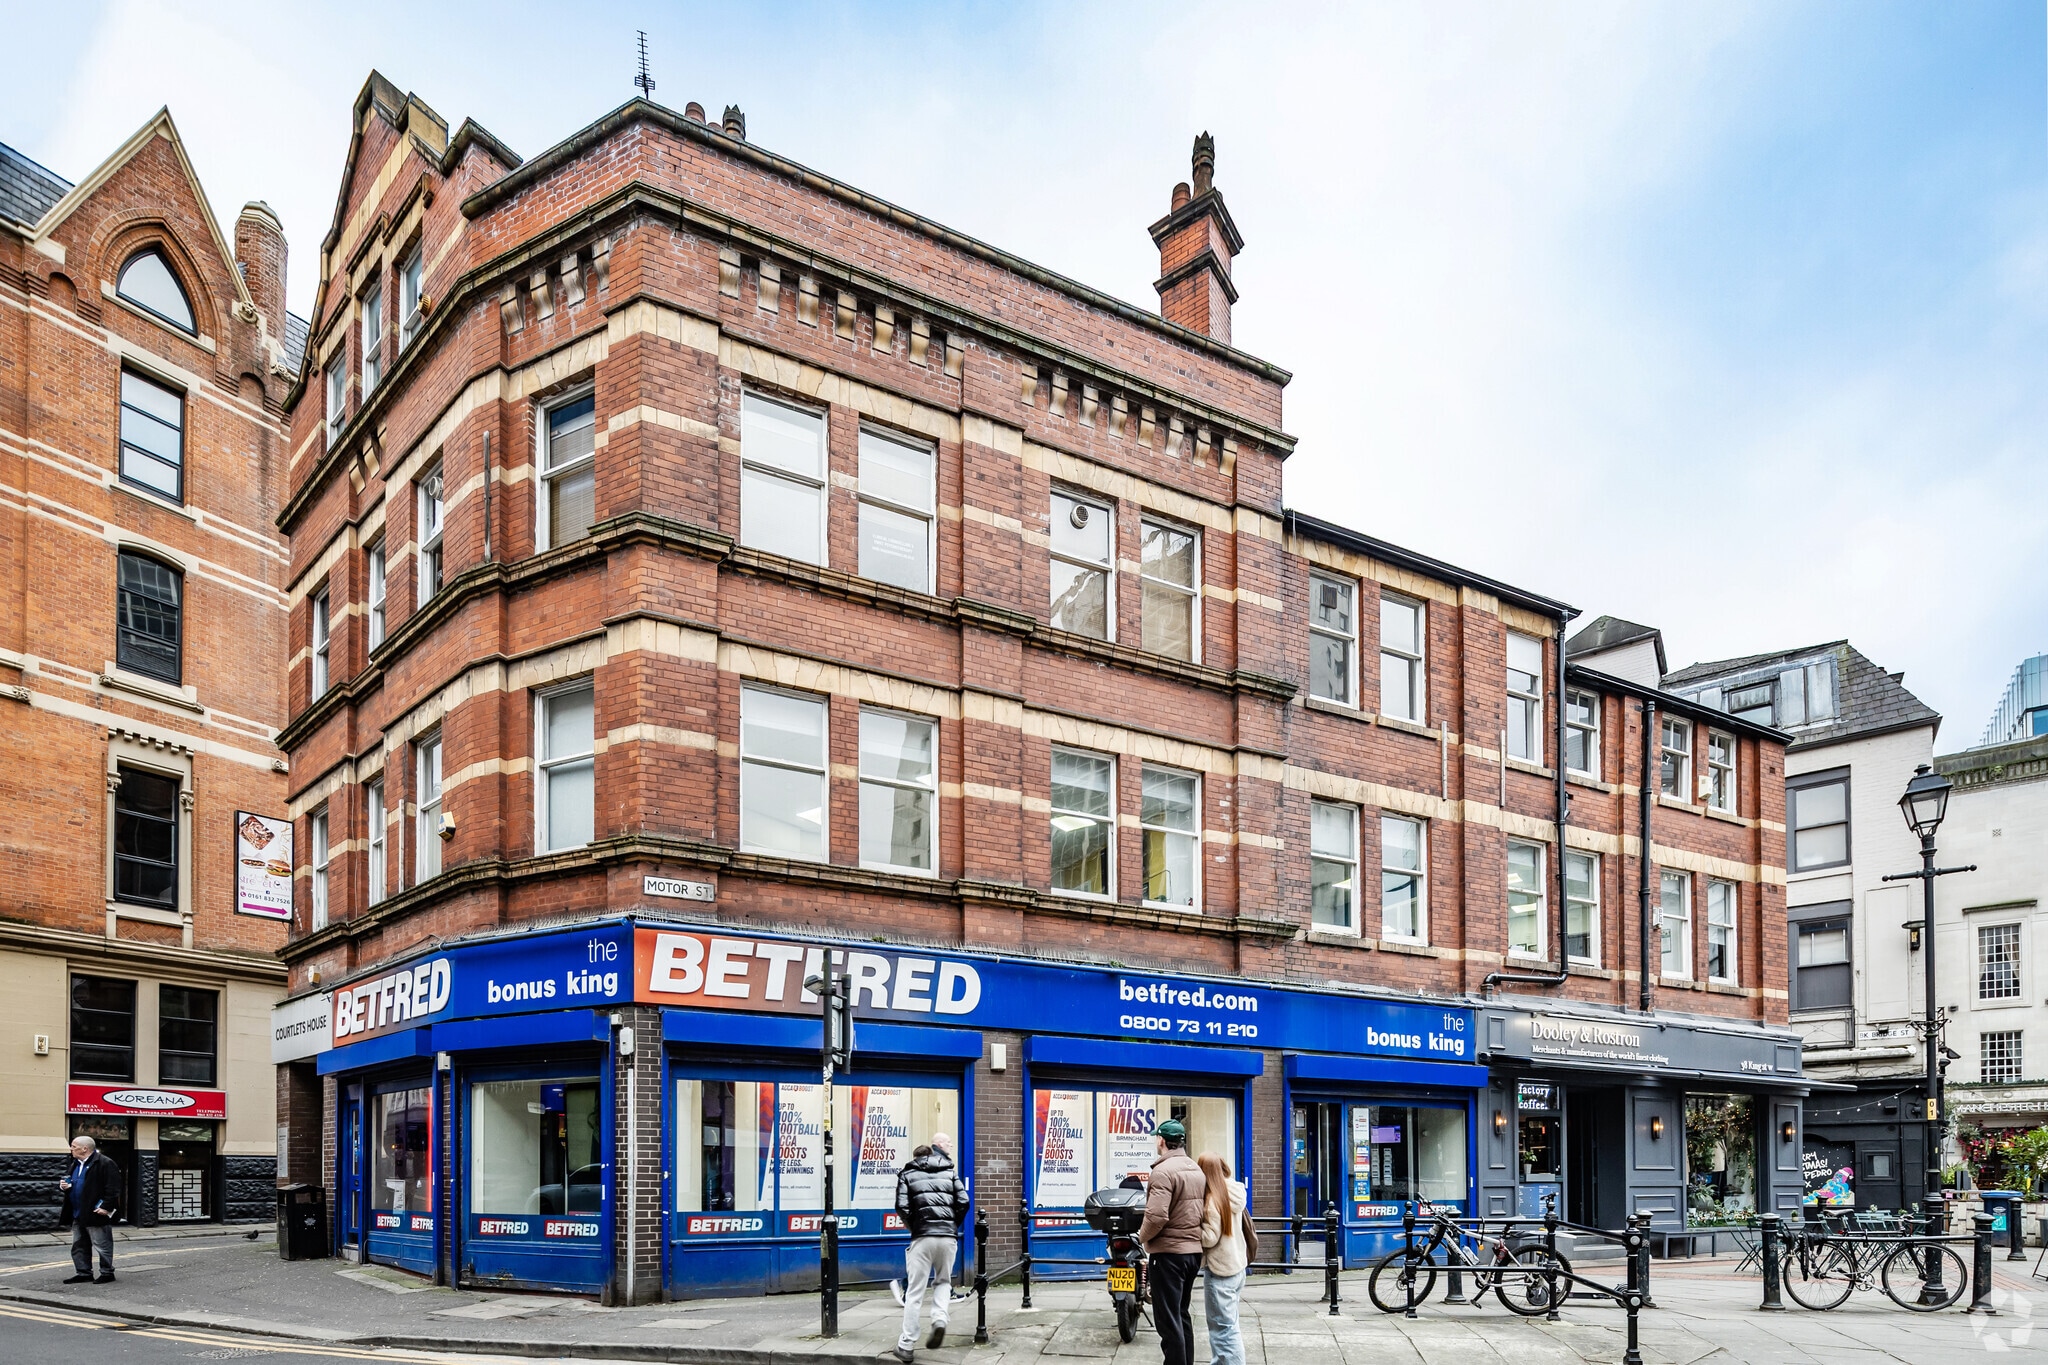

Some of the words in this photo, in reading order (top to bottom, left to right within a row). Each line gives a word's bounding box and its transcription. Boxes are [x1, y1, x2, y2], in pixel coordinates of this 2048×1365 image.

[647, 880, 689, 895] MOTOR
[588, 938, 618, 963] the
[488, 980, 556, 1003] bonus
[567, 969, 618, 997] king
[336, 958, 451, 1039] BETFRED
[1119, 979, 1258, 1012] betfred.com
[275, 1021, 307, 1041] COURTLETS
[306, 1014, 327, 1033] HOUSE
[1119, 1014, 1171, 1032] 0800
[1176, 1019, 1200, 1034] 73
[1206, 1022, 1222, 1035] 11
[1227, 1023, 1258, 1038] 210
[1442, 1013, 1465, 1032] the
[1532, 1021, 1577, 1047] Dooley
[1580, 1027, 1591, 1043] &
[1593, 1027, 1640, 1047] Rostron
[1366, 1026, 1422, 1049] bonus
[1428, 1032, 1465, 1056] king
[1532, 1045, 1560, 1055] Merchants
[1609, 1050, 1618, 1059] the
[1649, 1053, 1669, 1065] clothing
[1518, 1084, 1551, 1098] factory
[114, 1094, 185, 1105] KOREANA
[1111, 1094, 1140, 1108] DON'T
[869, 1106, 876, 1114] UP
[1956, 1102, 2036, 1113] MANCHESTER
[779, 1111, 802, 1123] 00%
[867, 1114, 891, 1126] 100%
[1050, 1117, 1070, 1127] 100%
[1108, 1108, 1156, 1134] MISS
[779, 1123, 819, 1135] OOTBALL
[865, 1126, 907, 1138] FOOTBALL
[1047, 1128, 1083, 1138] FOOTBALL
[779, 1135, 797, 1146] CCA
[864, 1138, 886, 1148] ACCA
[1046, 1138, 1065, 1148] ACCA
[862, 1149, 896, 1160] BOOSTS
[1045, 1149, 1074, 1160] BOOSTS
[1804, 1169, 1833, 1180] PEDRO
[1358, 1205, 1399, 1217] BETFRED
[376, 1216, 401, 1228] BETFRED
[480, 1220, 530, 1235] BETFRED
[690, 1217, 764, 1232] BETFRED
[546, 1222, 599, 1237] BETFRED
[1108, 1270, 1135, 1279] NU20
[1113, 1280, 1133, 1289] UYK
